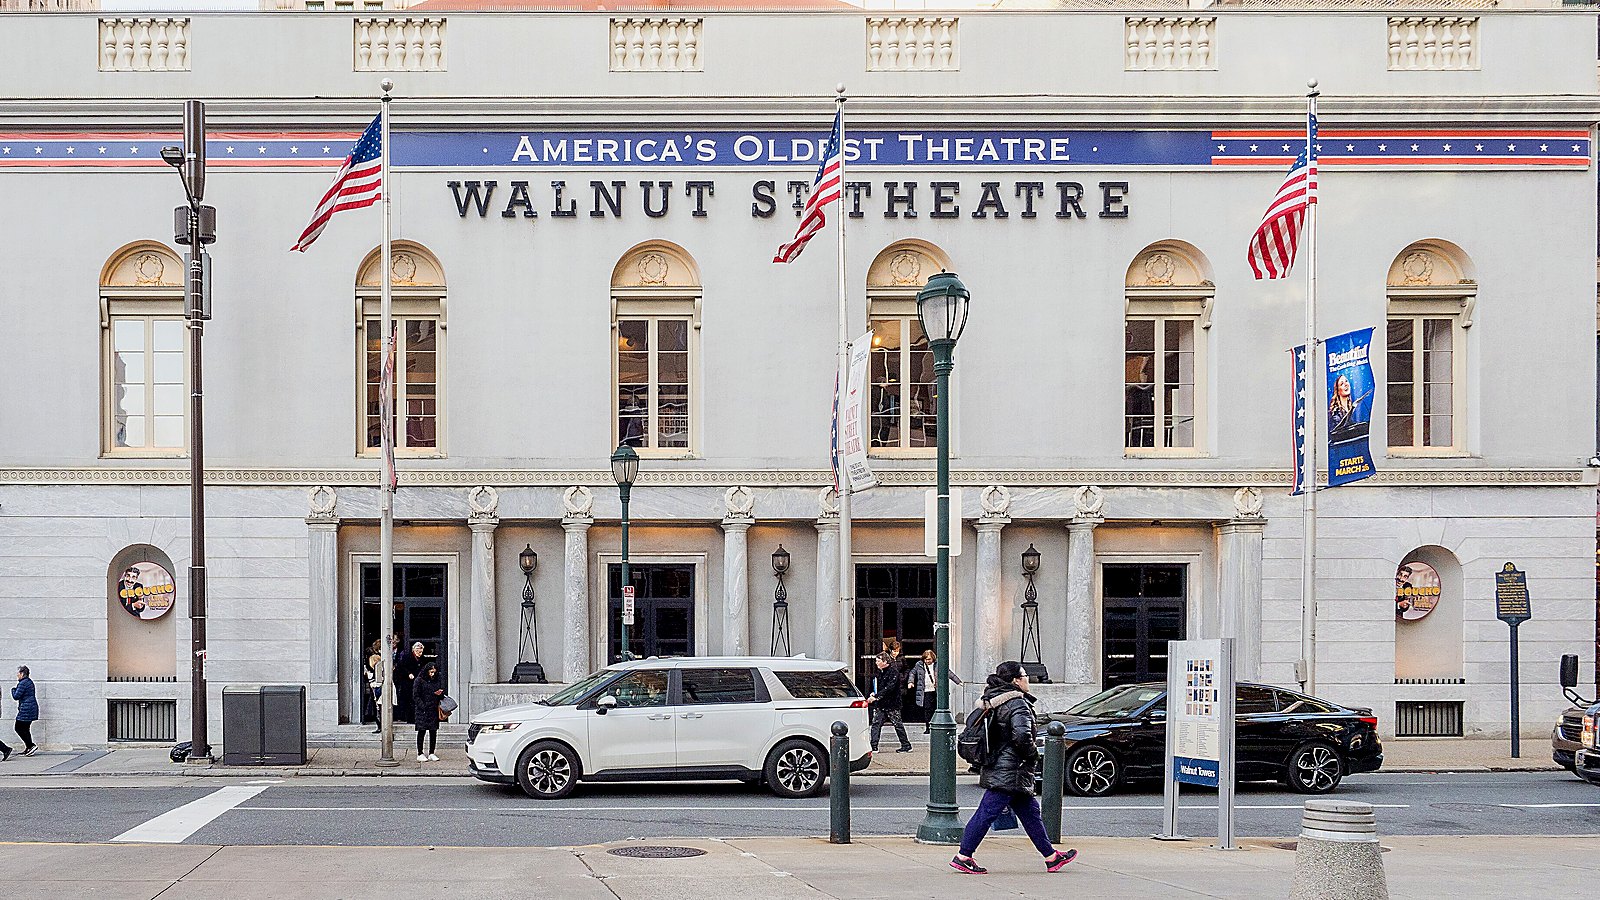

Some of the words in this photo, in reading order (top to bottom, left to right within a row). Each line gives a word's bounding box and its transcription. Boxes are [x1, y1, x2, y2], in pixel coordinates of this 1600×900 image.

[511, 135, 717, 161] AMERICA'S
[899, 134, 1070, 161] THEATRE
[447, 180, 715, 218] WALNUT
[845, 181, 1129, 218] THEATRE
[1328, 344, 1368, 366] Beautiful
[1340, 456, 1364, 467] STARTS
[1335, 464, 1362, 476] MARCH
[120, 584, 174, 598] GROUCHO
[1396, 586, 1440, 597] ROUCHO
[1181, 765, 1198, 776] Walnut
[1198, 767, 1215, 777] Towers
